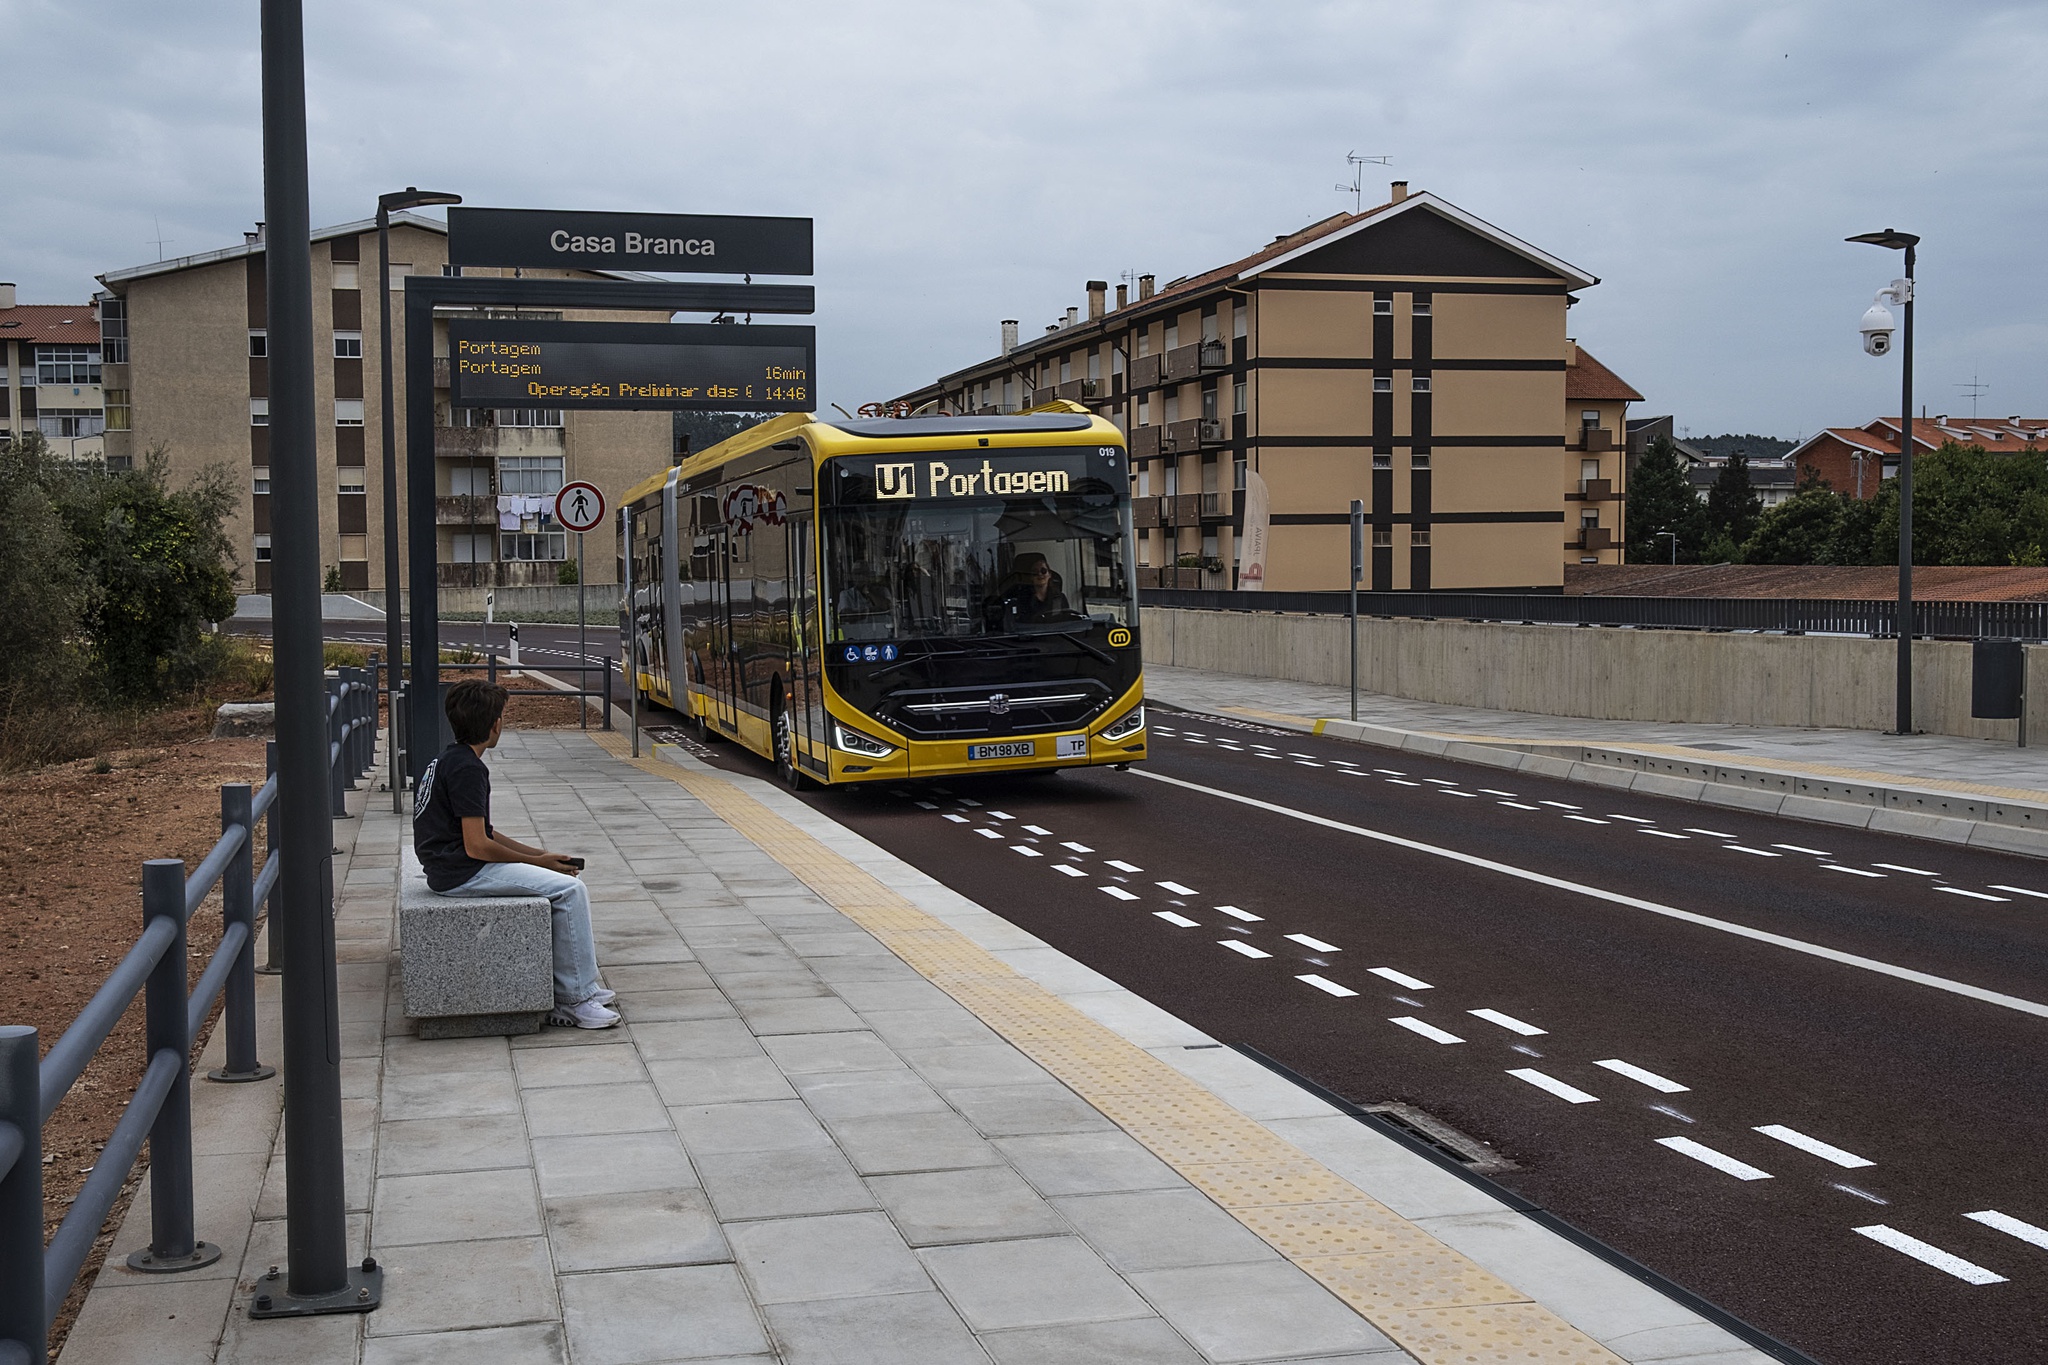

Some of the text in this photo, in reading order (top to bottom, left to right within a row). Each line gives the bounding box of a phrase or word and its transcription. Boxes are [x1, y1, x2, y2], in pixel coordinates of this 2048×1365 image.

[550, 229, 716, 256] Casa Branca
[459, 340, 541, 359] Portagem
[459, 359, 807, 380] Portagem 16min
[527, 381, 610, 400] Operação
[706, 384, 740, 398] das
[765, 386, 807, 400] 14:46
[1098, 447, 1116, 457] 019
[875, 459, 1070, 498] U1 Portagem
[1070, 740, 1085, 751] TP
